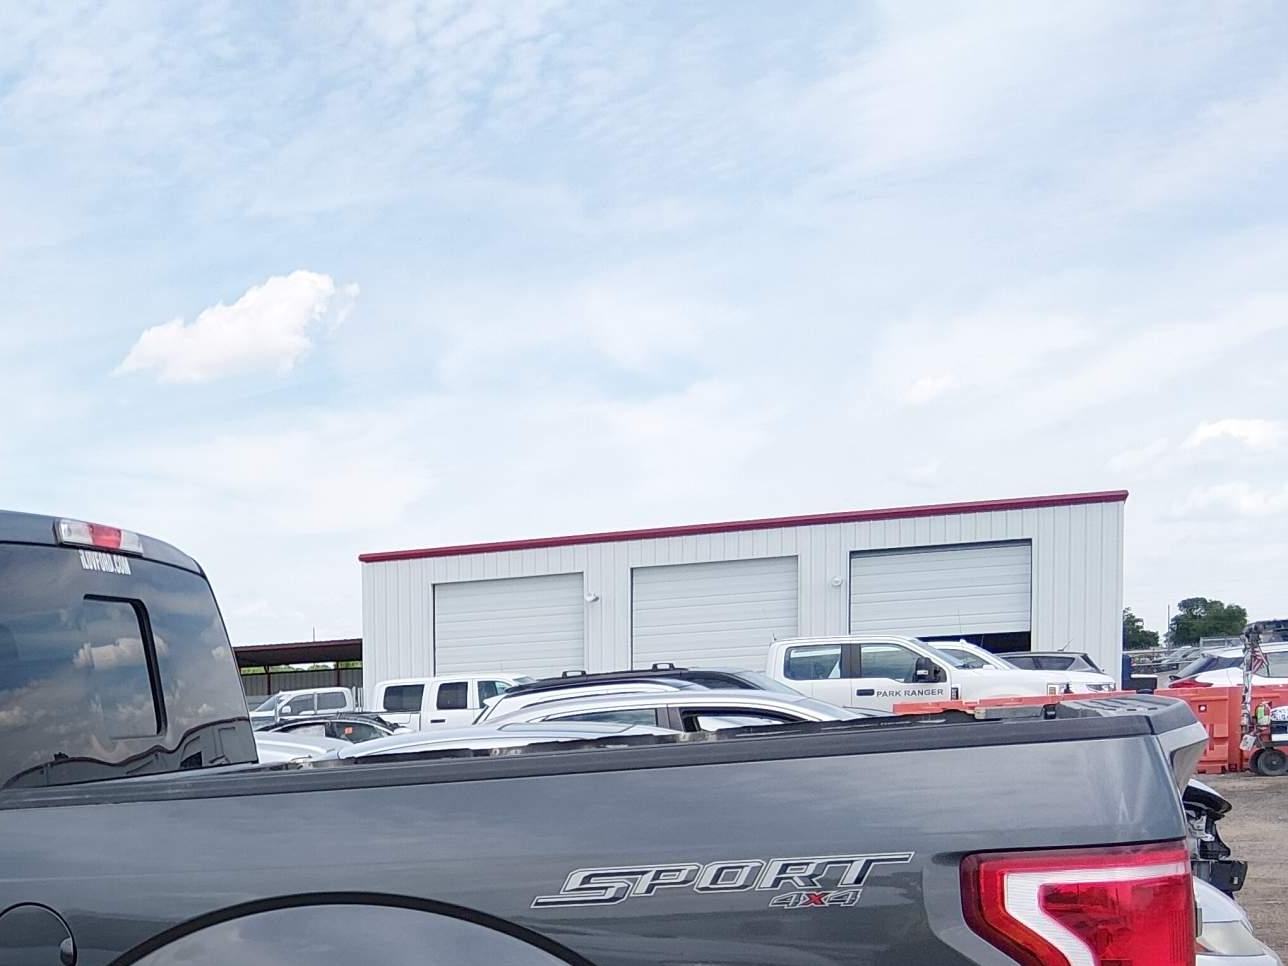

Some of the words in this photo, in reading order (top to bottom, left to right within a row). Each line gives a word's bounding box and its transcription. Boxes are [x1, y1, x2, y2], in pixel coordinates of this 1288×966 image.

[876, 689, 902, 698] PARK
[904, 688, 944, 697] RANGER
[530, 850, 916, 909] SPORT
